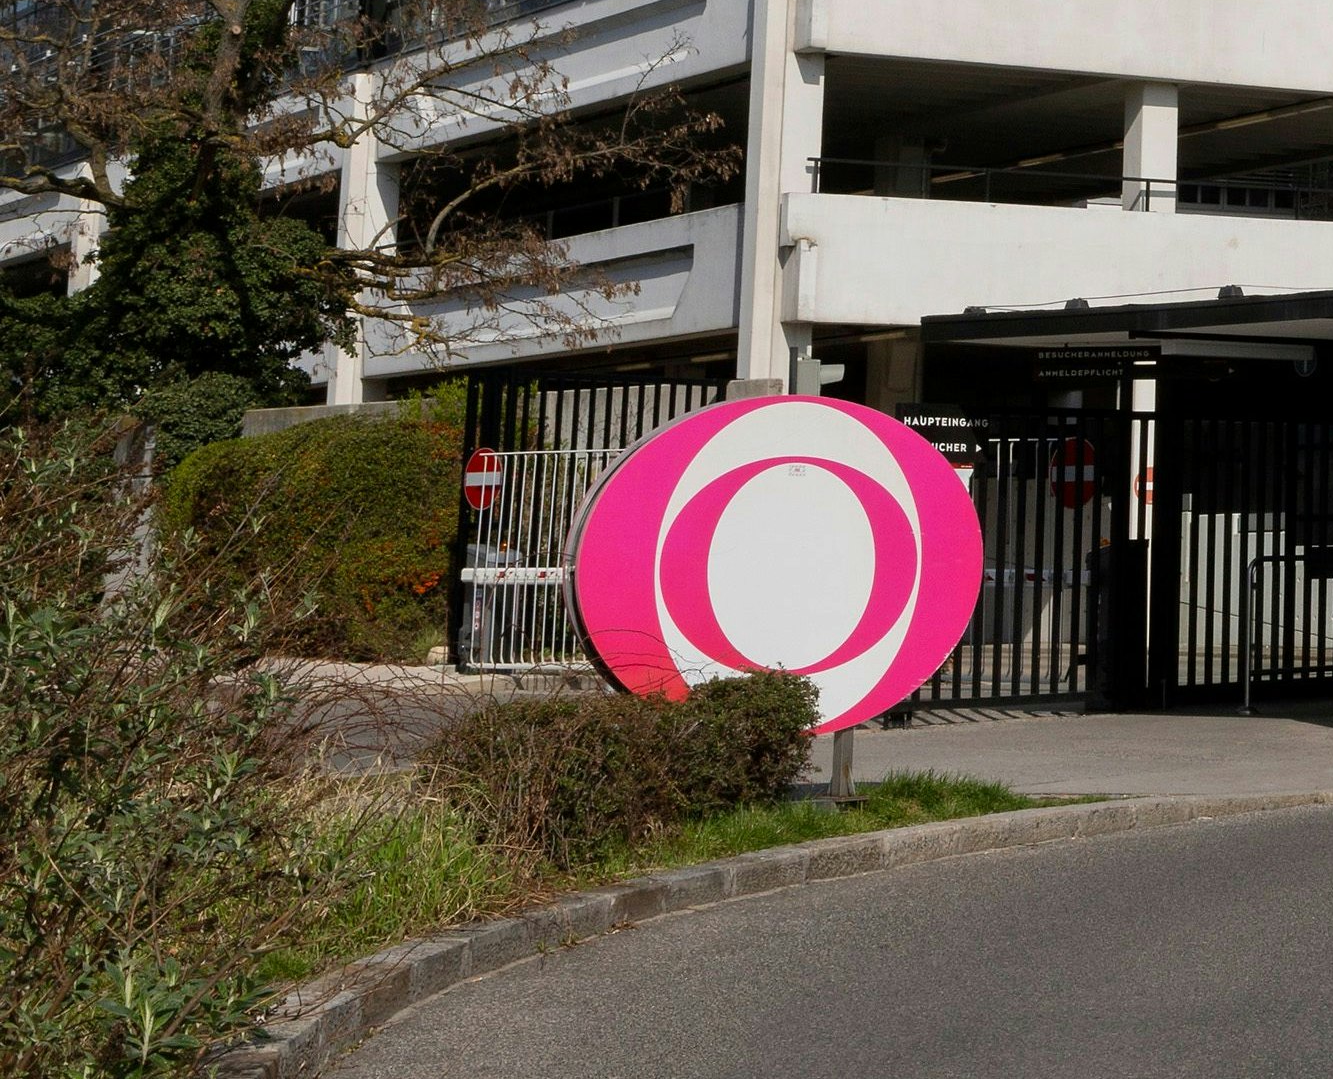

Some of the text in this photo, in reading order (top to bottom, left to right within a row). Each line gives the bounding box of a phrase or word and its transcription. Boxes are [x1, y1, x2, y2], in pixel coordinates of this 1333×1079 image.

[1038, 350, 1150, 359] BESUCHERANMELDUNG
[1038, 368, 1124, 377] ANMELDEPFLICHT
[904, 415, 989, 428] HAUPTEINGANG
[931, 443, 967, 453] UCHER
